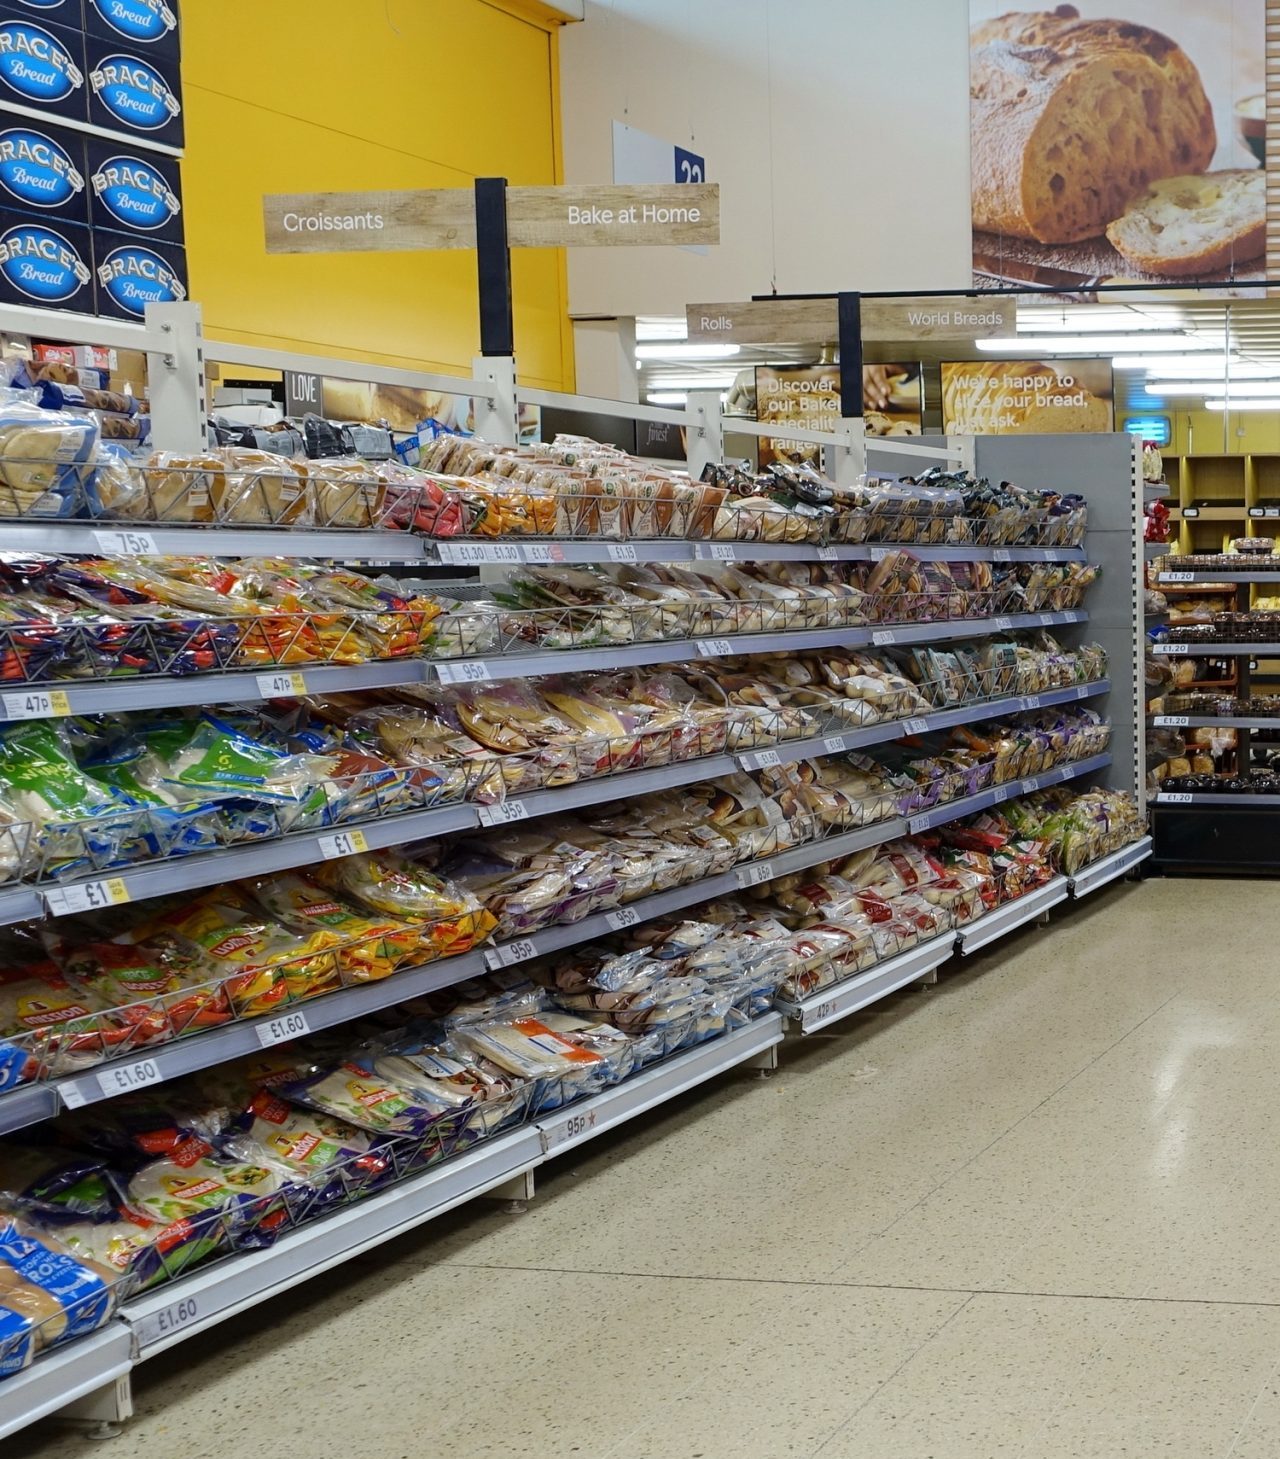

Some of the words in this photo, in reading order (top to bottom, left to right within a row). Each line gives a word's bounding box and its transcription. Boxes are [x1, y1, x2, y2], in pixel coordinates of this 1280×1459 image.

[111, 0, 153, 28] Bread
[0, 32, 84, 89] RACE'S
[10, 59, 56, 86] Bread
[89, 65, 181, 117] BRACE'S
[115, 90, 157, 115] Bread
[0, 139, 85, 192] RACE'S
[12, 166, 58, 192] Bread
[92, 166, 181, 215] BRACE'S
[116, 192, 156, 215] Bread
[283, 212, 384, 233] Croissants
[568, 205, 613, 224] Bake
[618, 207, 637, 223] at
[641, 204, 700, 223] Home
[20, 263, 65, 286] Bread
[97, 256, 186, 302] BRACE'S
[123, 282, 163, 302] Bread
[700, 315, 733, 331] Rolls
[908, 311, 951, 326] World
[953, 310, 1003, 326] Breads
[291, 374, 317, 403] LOVE
[768, 378, 836, 394] Discover
[953, 373, 999, 389] We're
[1002, 372, 1052, 393] happy
[1057, 374, 1075, 388] to
[768, 399, 796, 412] our
[1035, 391, 1088, 409] bread,
[990, 412, 1020, 428] ask.
[116, 533, 149, 554] 75p
[461, 546, 485, 560] £1.30
[494, 545, 518, 560] £1.30
[1168, 572, 1192, 580] £1.20
[1162, 645, 1186, 653] £1.20
[462, 665, 483, 680] 95p
[273, 676, 290, 692] 47p
[26, 696, 49, 713] 47p
[1163, 717, 1187, 725] £1.20
[1168, 794, 1191, 802] £1.20
[501, 802, 522, 819] 95p
[334, 832, 353, 855] £1
[756, 867, 770, 881] 85p
[85, 883, 108, 906] £1
[616, 911, 635, 925] 95p
[510, 941, 533, 960] 95p
[23, 1006, 87, 1026] mission
[816, 1004, 830, 1019] 42p
[271, 1015, 304, 1039] £1.60
[115, 1061, 156, 1088] £1.60
[567, 1116, 585, 1137] 95p
[158, 1298, 196, 1331] £1.60
